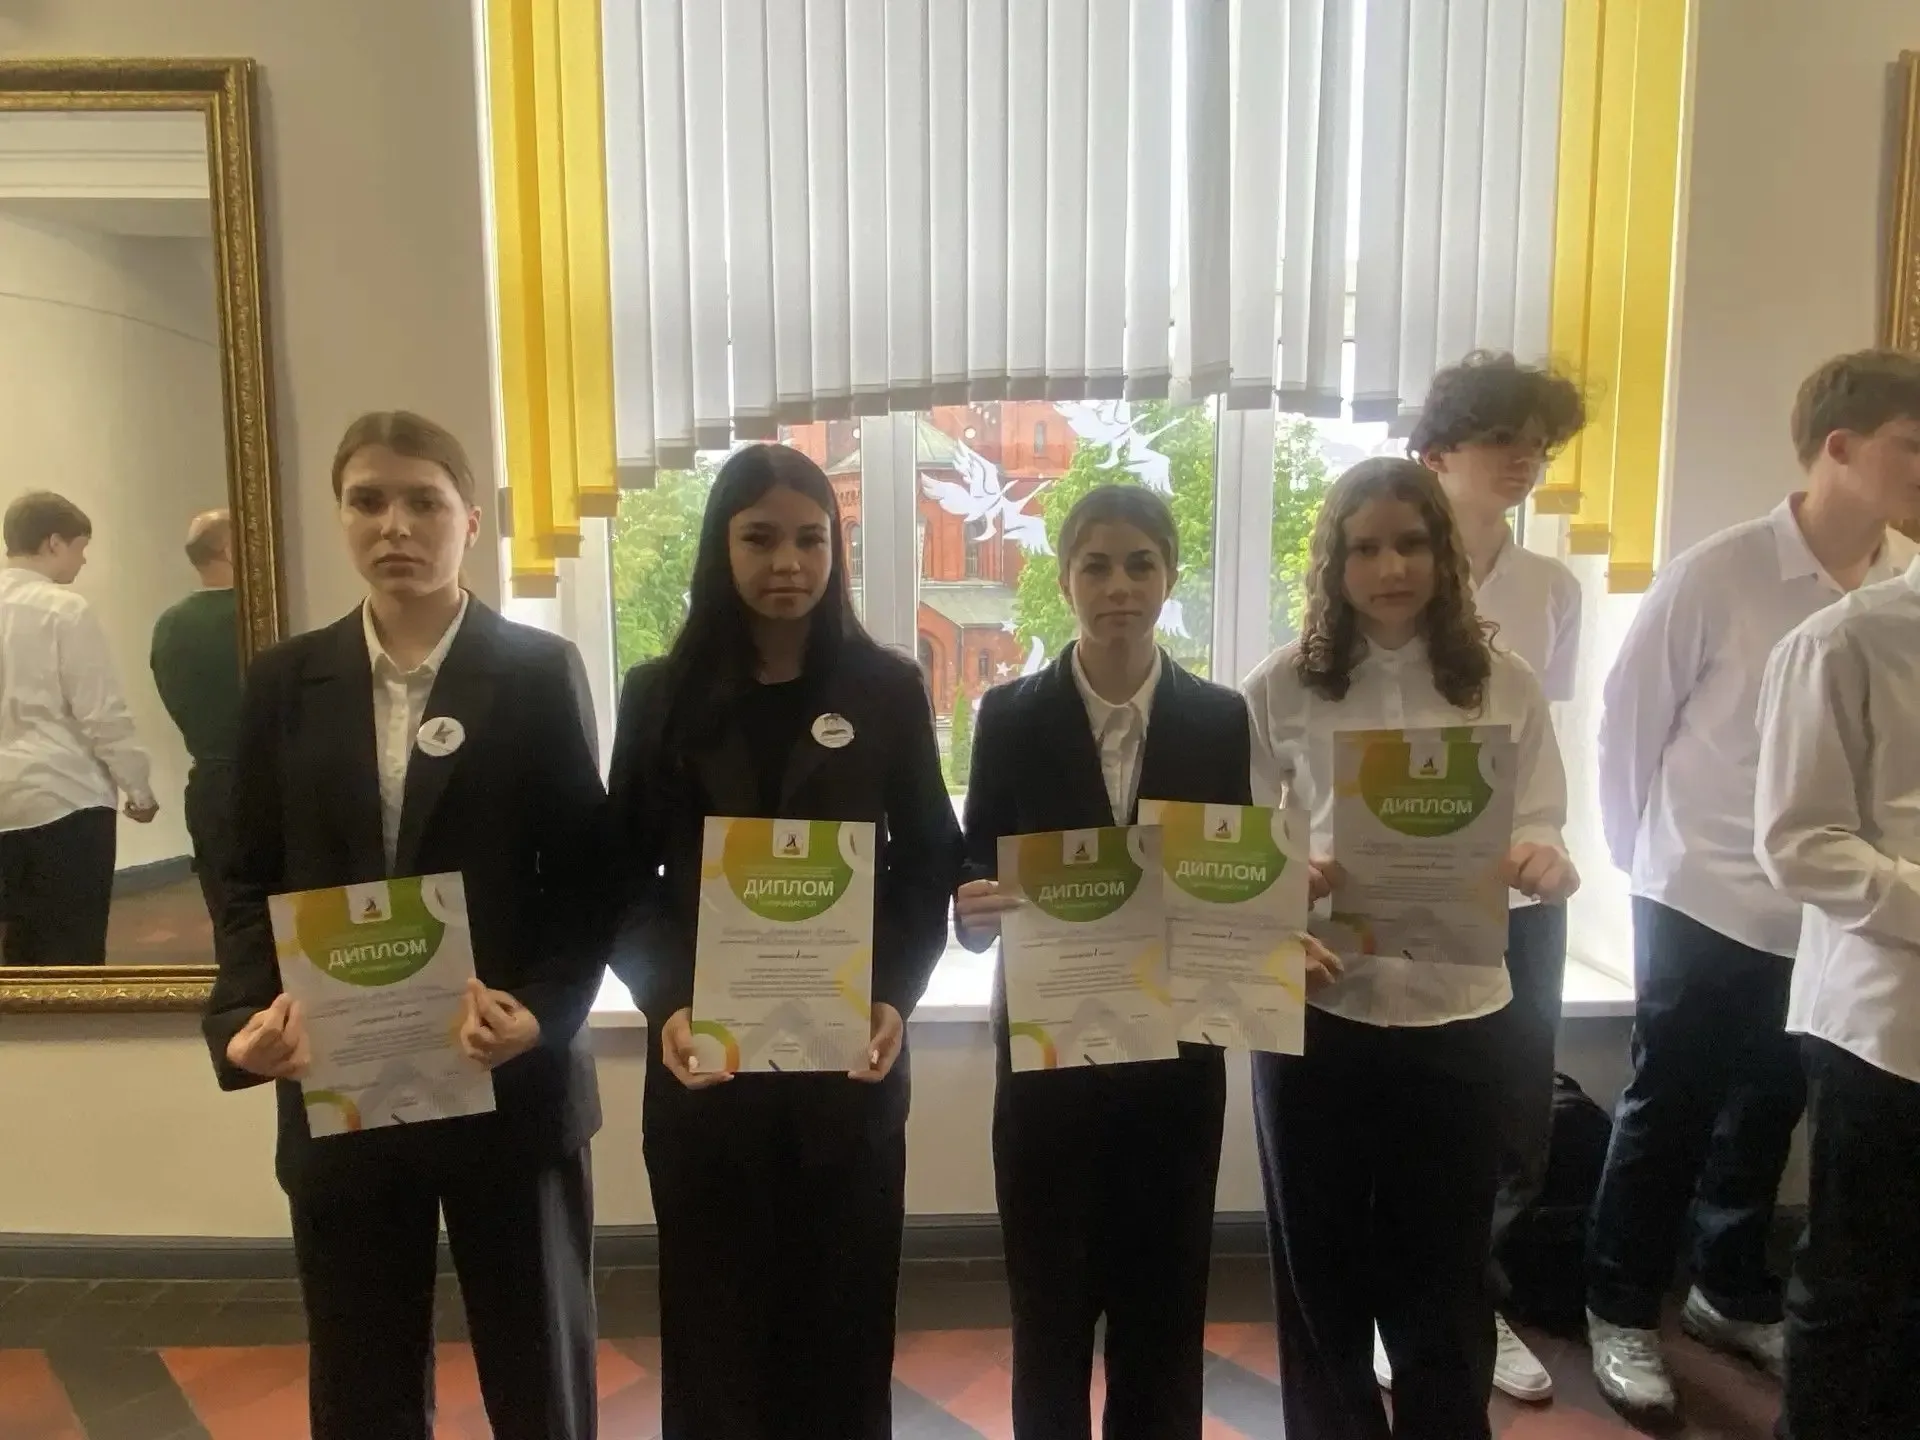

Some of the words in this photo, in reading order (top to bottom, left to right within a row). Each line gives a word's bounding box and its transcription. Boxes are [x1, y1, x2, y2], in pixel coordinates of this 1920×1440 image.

[1379, 797, 1473, 816] ДИПЛОМ
[1176, 860, 1267, 882] ДИПЛОМ
[743, 878, 835, 900] ДИПЛОМ
[1037, 880, 1125, 902] ДИПЛОМ
[327, 938, 428, 970] ДИПЛОМ
